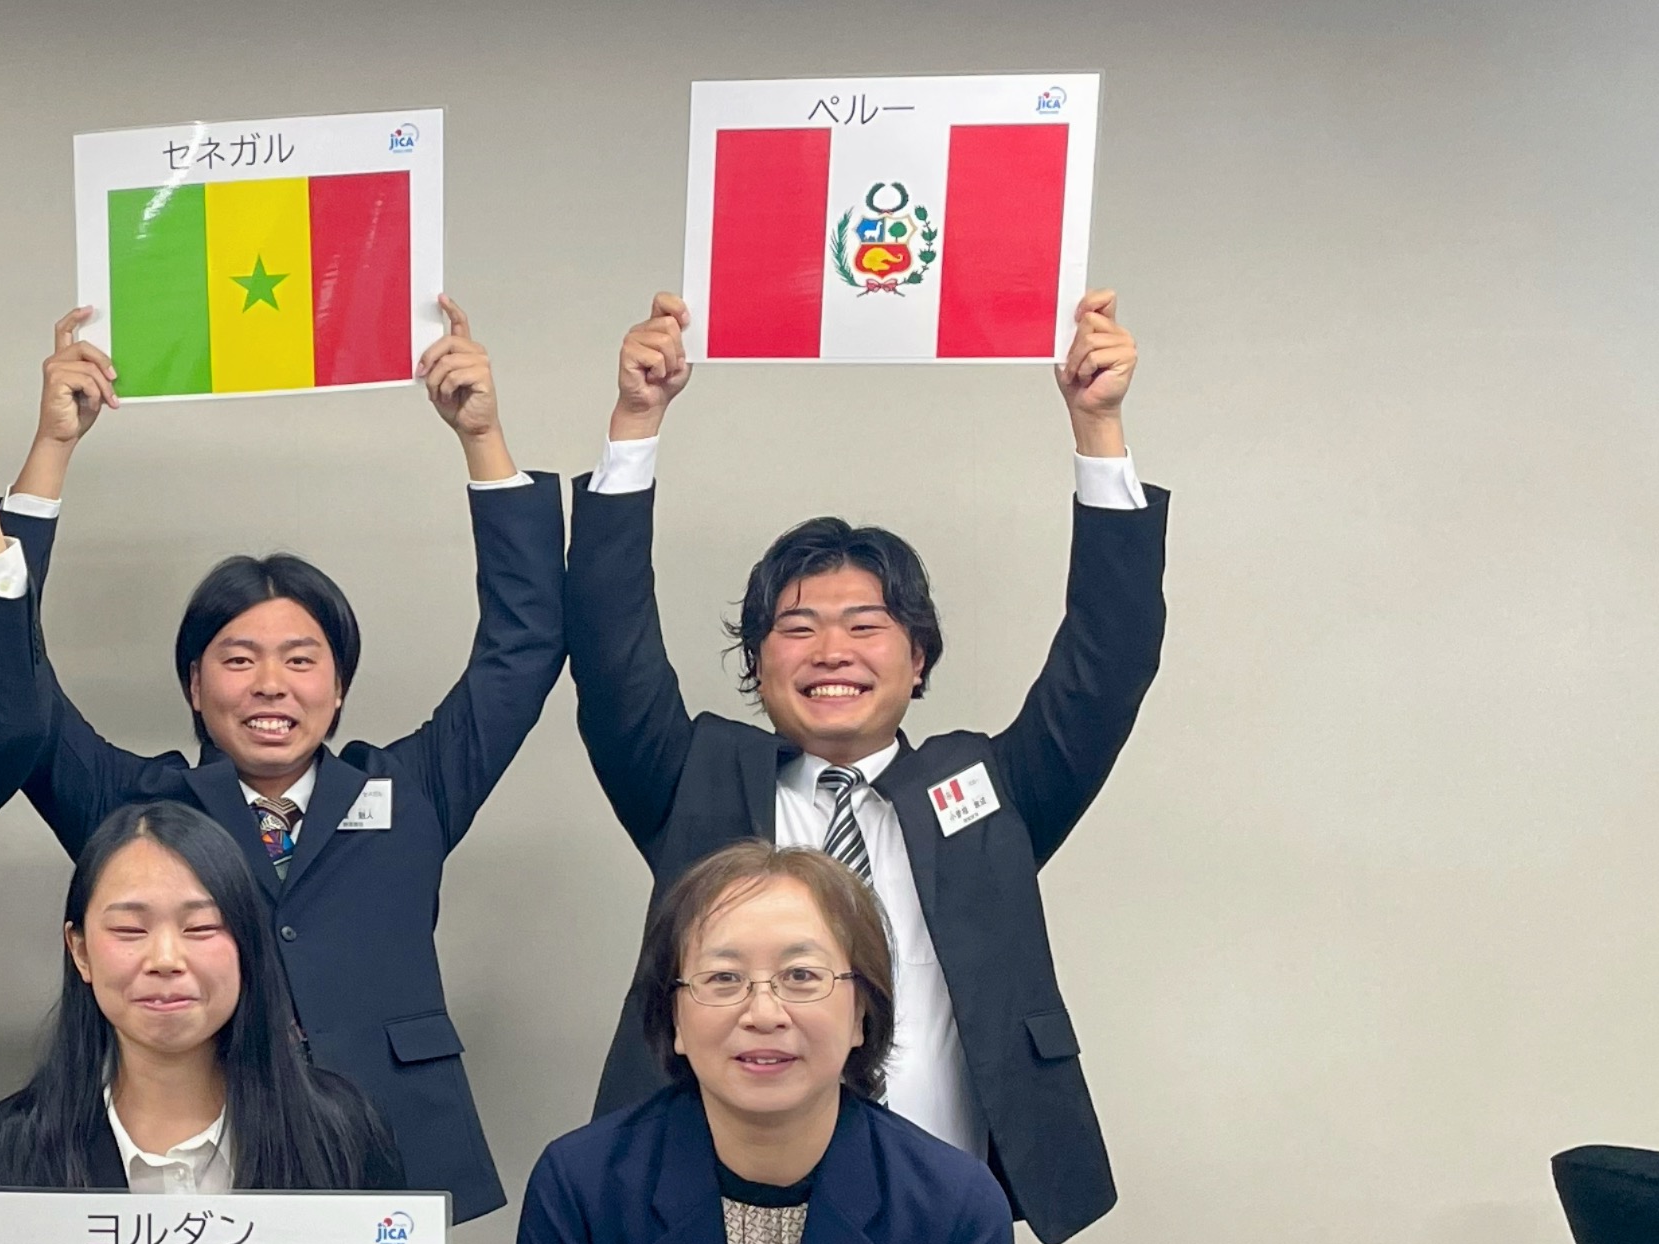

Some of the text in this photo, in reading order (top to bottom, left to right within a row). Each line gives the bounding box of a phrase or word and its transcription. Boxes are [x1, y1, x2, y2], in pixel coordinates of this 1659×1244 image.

[807, 93, 915, 126] ペルー
[162, 132, 295, 170] セネガル
